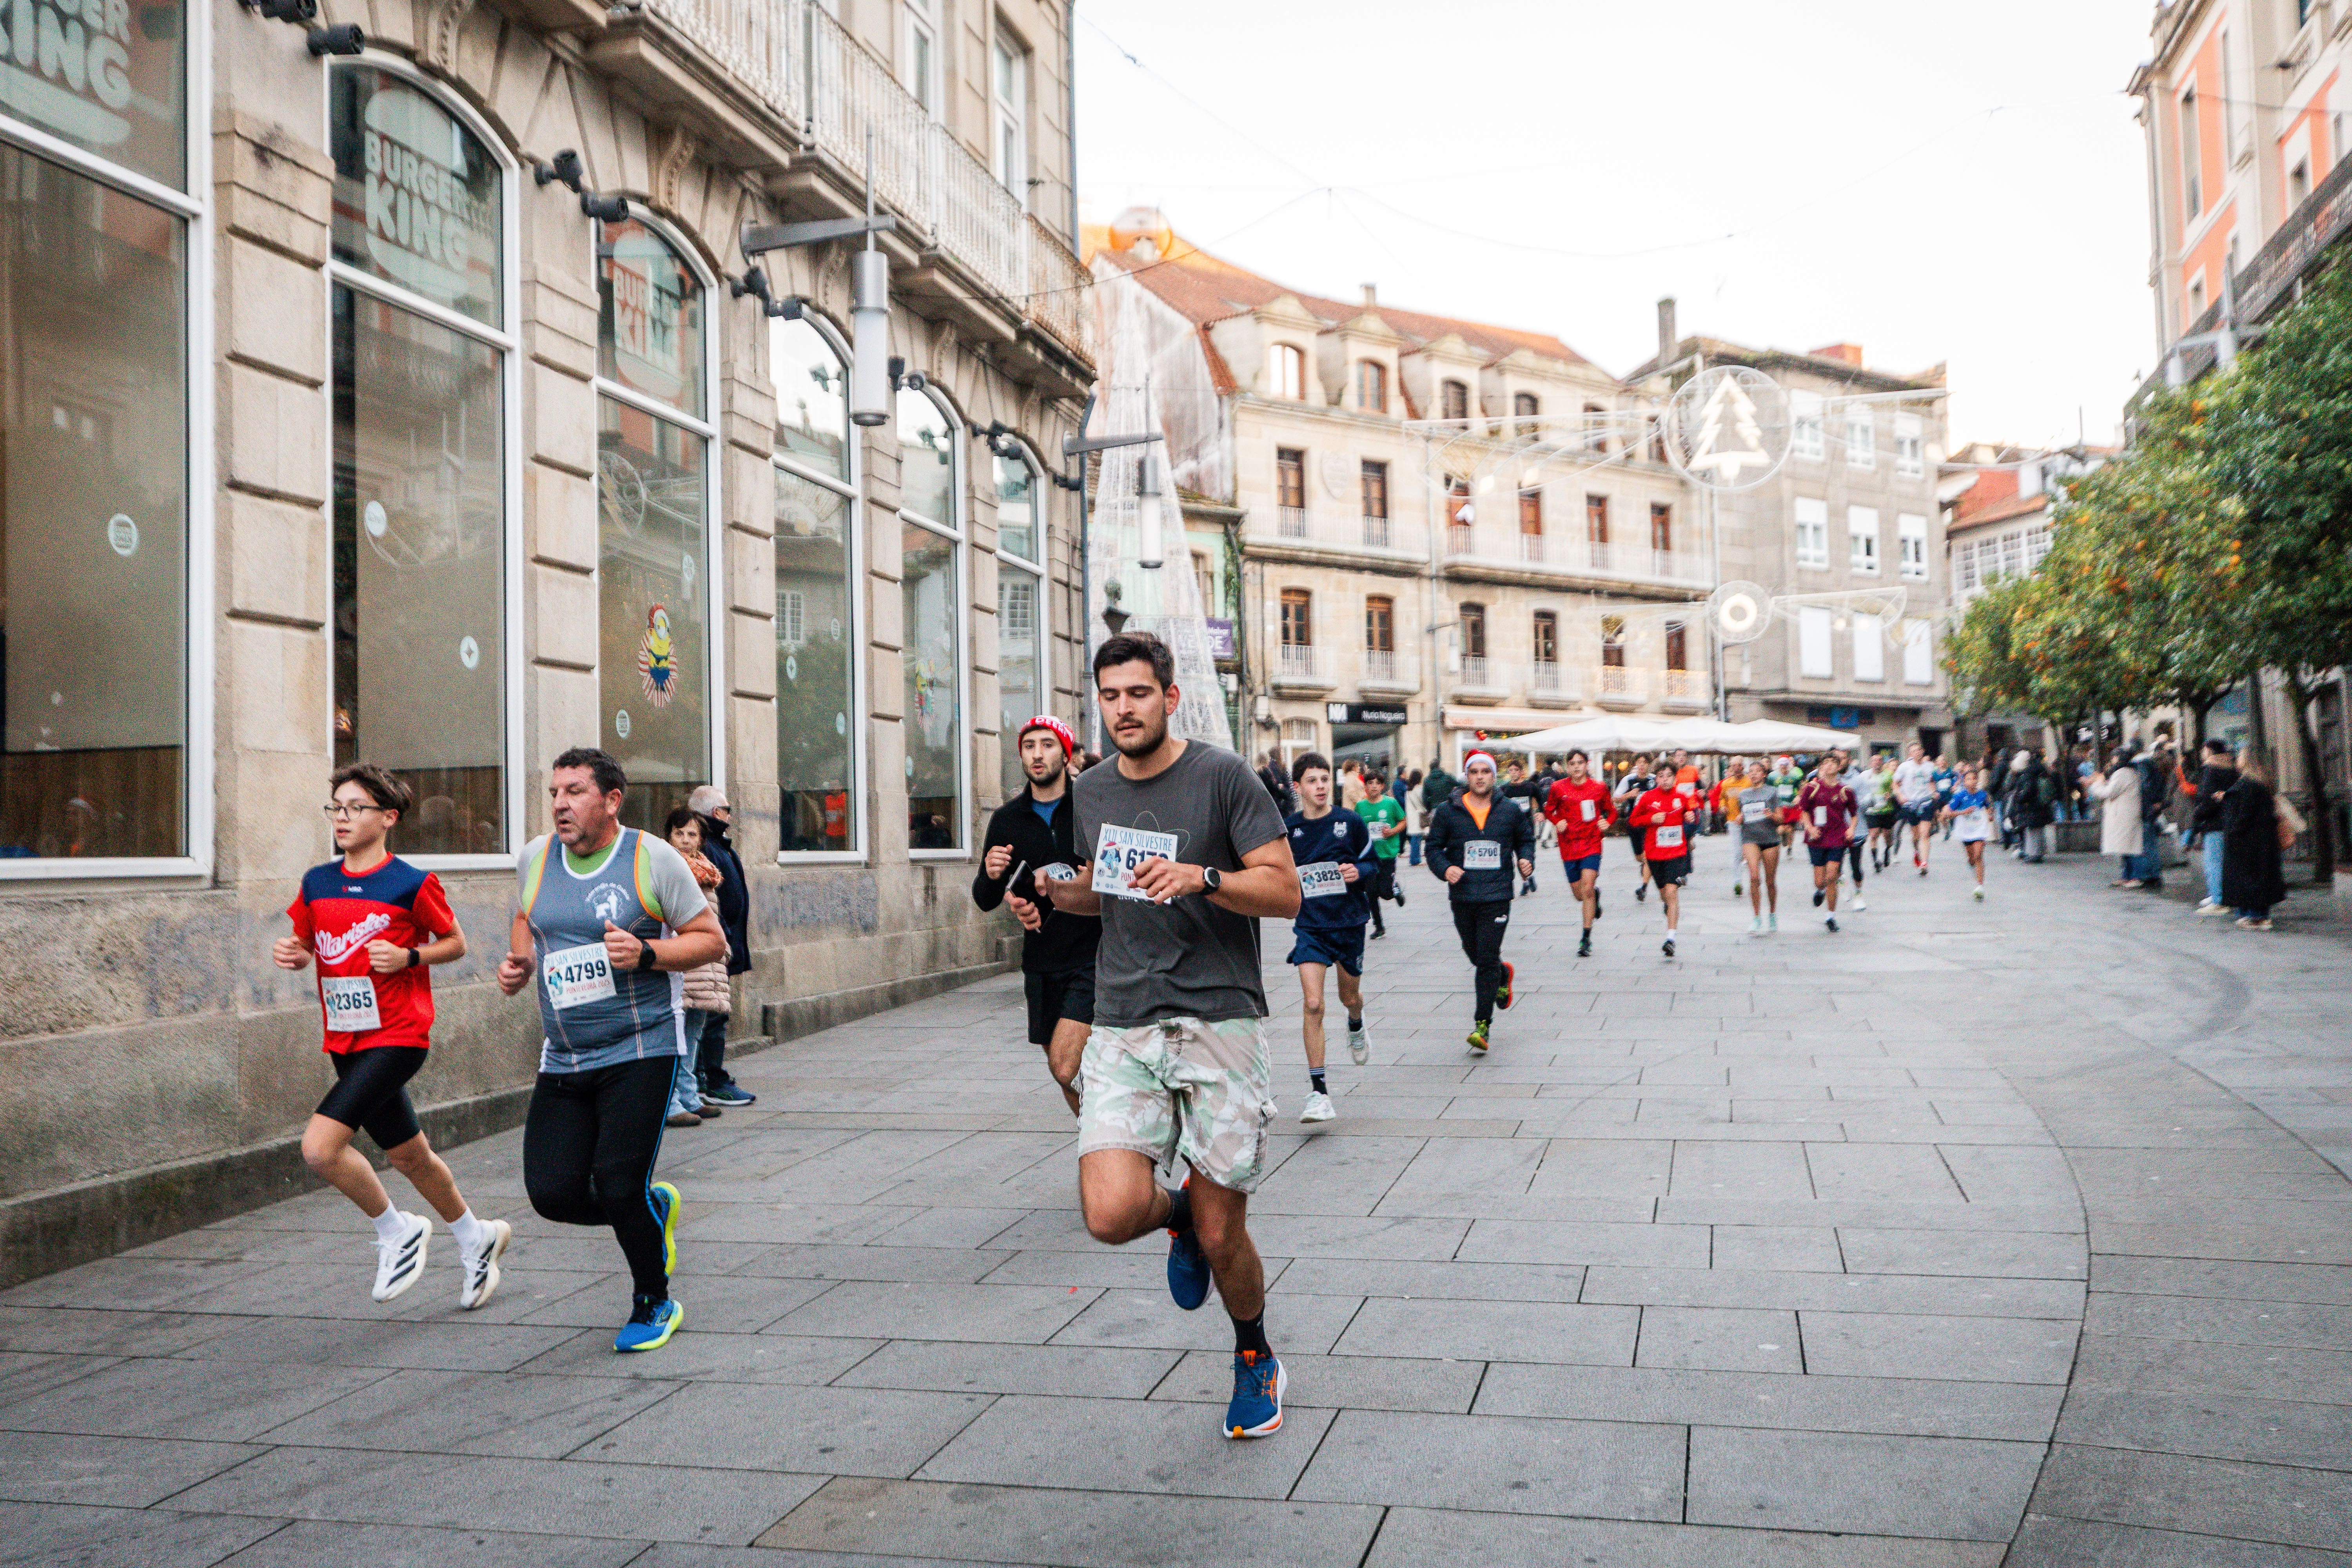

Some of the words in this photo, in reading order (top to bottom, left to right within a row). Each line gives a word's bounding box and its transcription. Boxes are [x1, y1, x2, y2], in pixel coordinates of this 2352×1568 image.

[364, 131, 472, 222] BURGER
[365, 172, 472, 273] KING
[1035, 717, 1066, 737] DEER!
[1119, 831, 1134, 846] SAN
[1135, 833, 1172, 851] SILVESTRE
[1314, 869, 1341, 882] 3825
[315, 912, 391, 958] Maristas
[555, 953, 568, 965] SAN
[569, 946, 603, 962] SILVESTRE
[564, 959, 606, 983] 4799
[566, 981, 597, 994] PONTEVEDRA
[336, 990, 372, 1010] 2365
